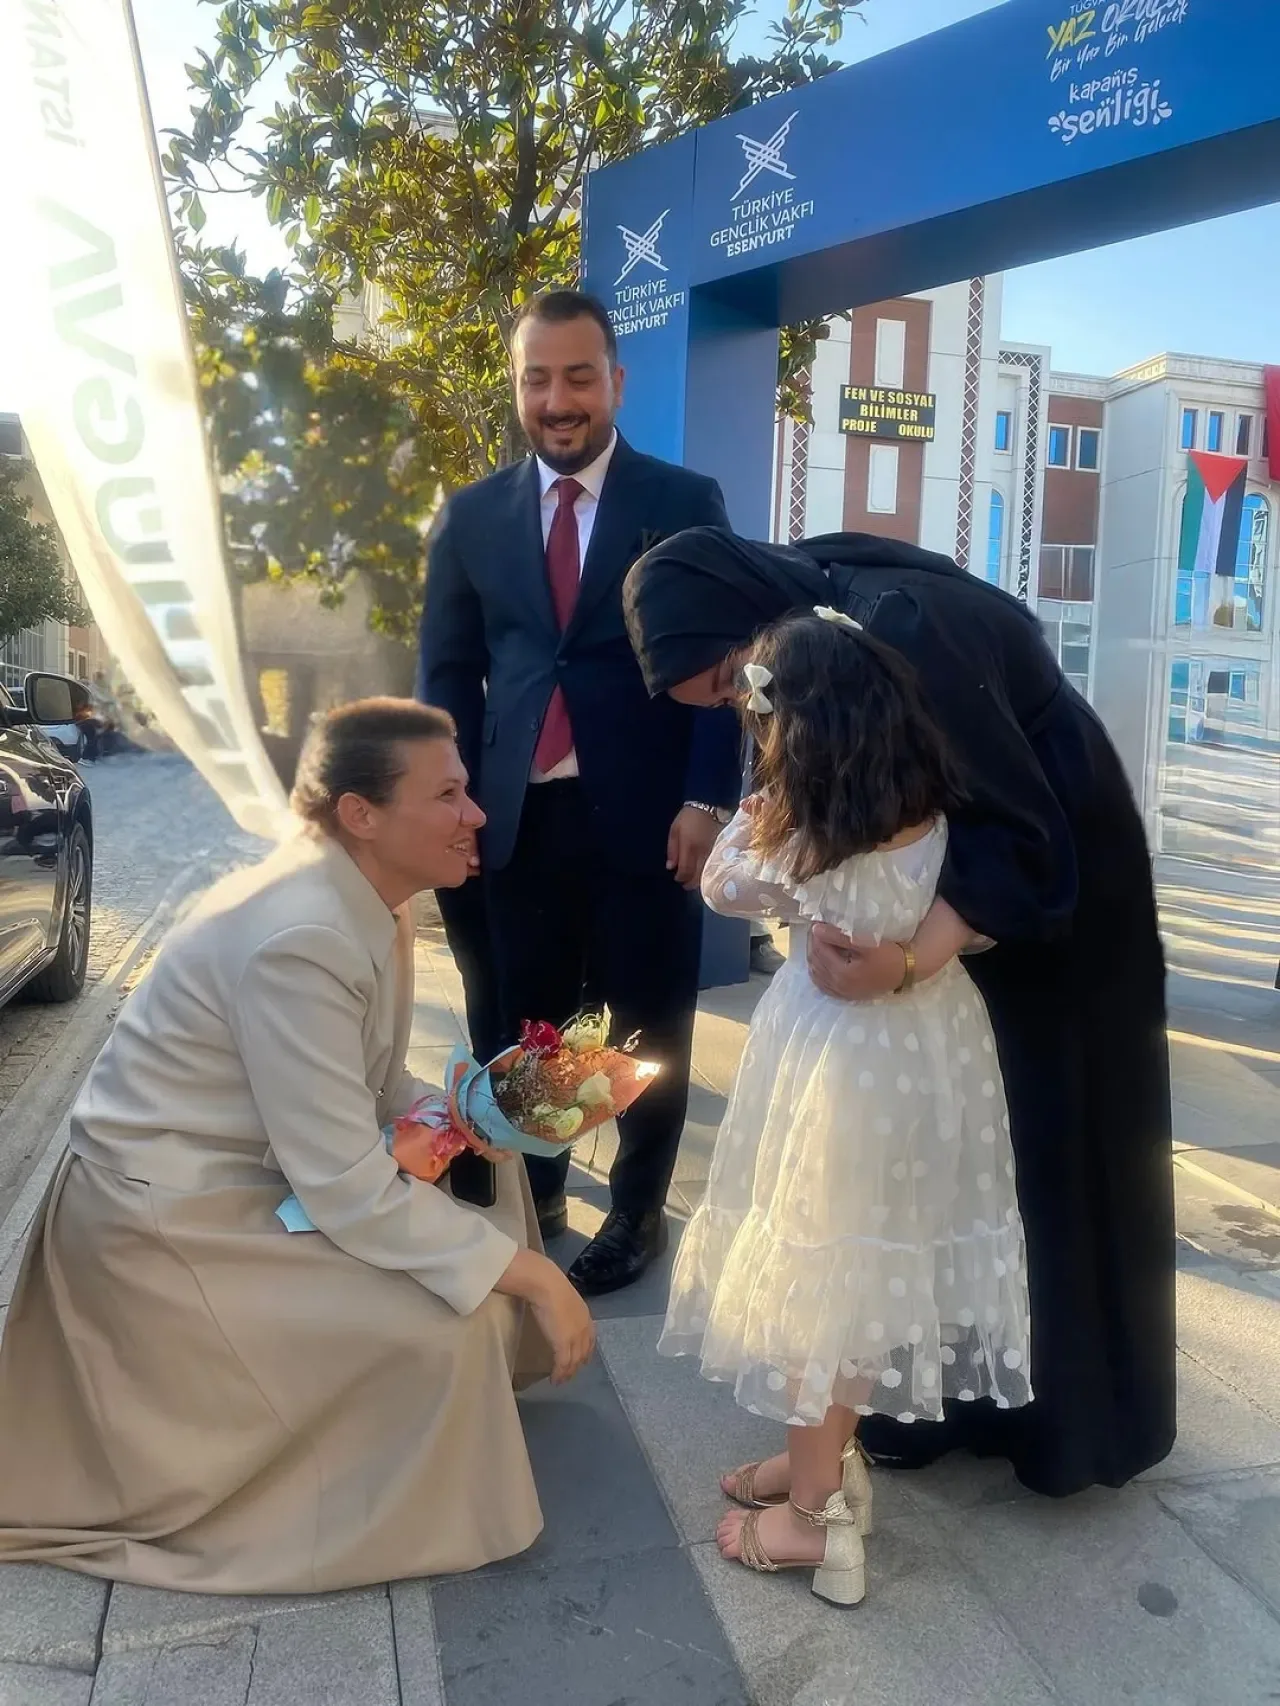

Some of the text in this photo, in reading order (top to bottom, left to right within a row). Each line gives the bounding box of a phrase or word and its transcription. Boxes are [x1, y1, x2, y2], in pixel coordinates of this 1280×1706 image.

[1046, 10, 1096, 60] YAZ
[1050, 58, 1071, 83] Bir
[1105, 32, 1128, 57] Bir
[732, 188, 794, 221] TÜRKİYE
[771, 200, 814, 227] VAKFI
[727, 224, 795, 257] ESENYURT
[615, 279, 667, 305] TÜRKİYE
[649, 292, 685, 313] VAKFI
[844, 387, 934, 407] FEN VE SOSYAL
[860, 403, 918, 422] BİLİMLER
[842, 419, 934, 438] PROJE OKULU
